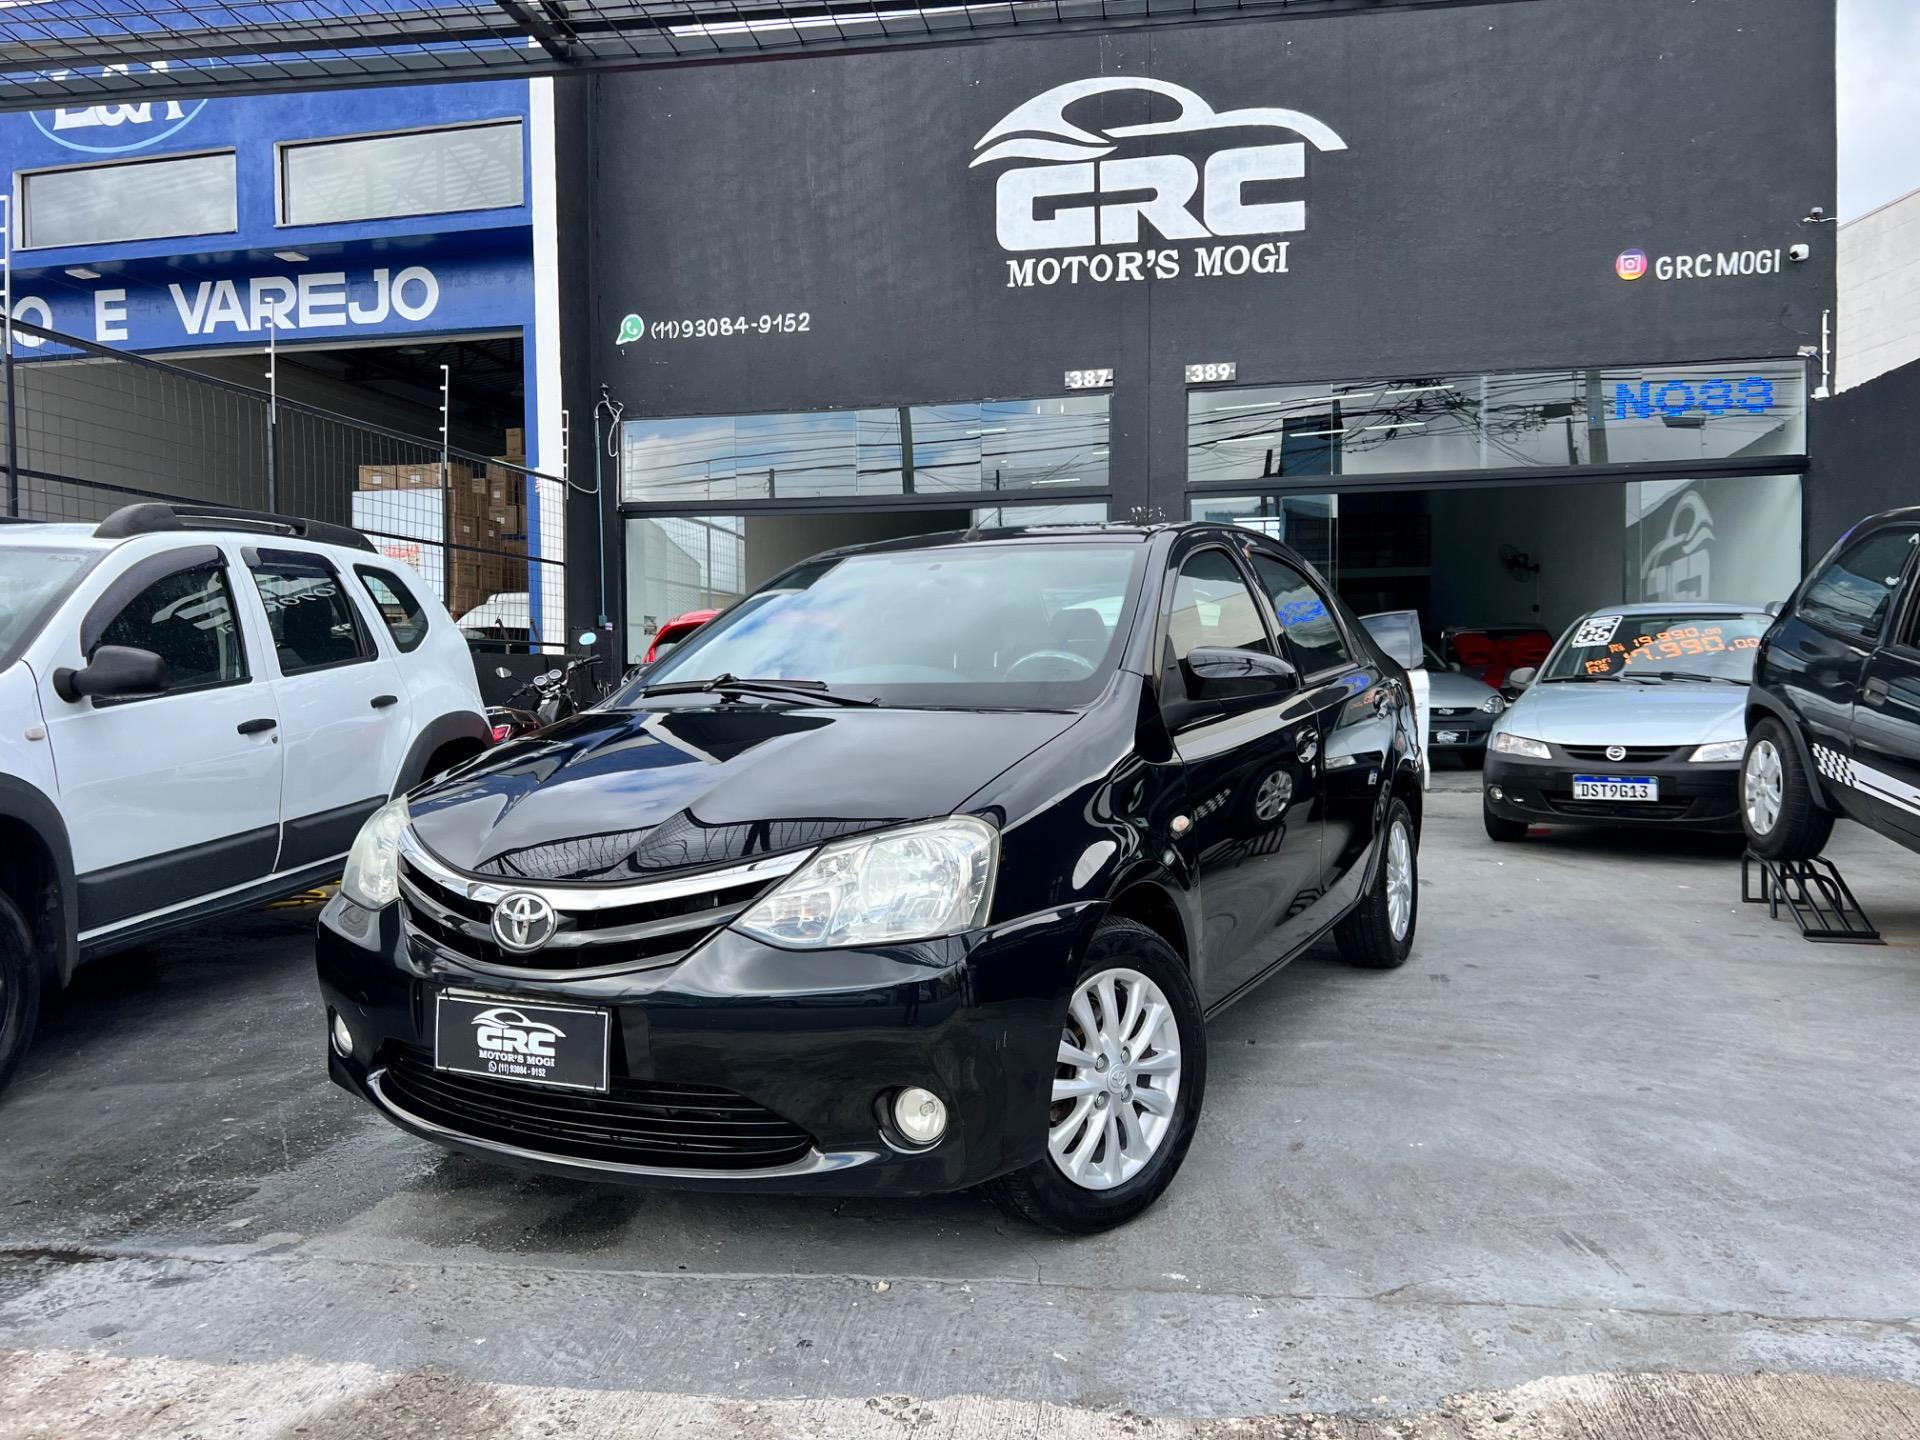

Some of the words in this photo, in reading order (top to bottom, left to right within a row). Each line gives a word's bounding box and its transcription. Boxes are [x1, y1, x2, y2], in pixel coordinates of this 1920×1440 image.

[996, 142, 1305, 251] GRC
[1006, 250, 1180, 288] MOTOR'S
[1194, 241, 1290, 277] MOGI
[0, 296, 53, 348] O
[95, 288, 128, 342] E
[168, 265, 440, 335] VAREJO
[651, 312, 811, 340] (11)93084-9152
[1069, 370, 1109, 388] 387
[1190, 363, 1231, 383] 389
[1581, 783, 1649, 799] DST9G13
[477, 1025, 556, 1057] GRC
[479, 1049, 525, 1064] MOTOR'S
[526, 1056, 556, 1067] MOGI
